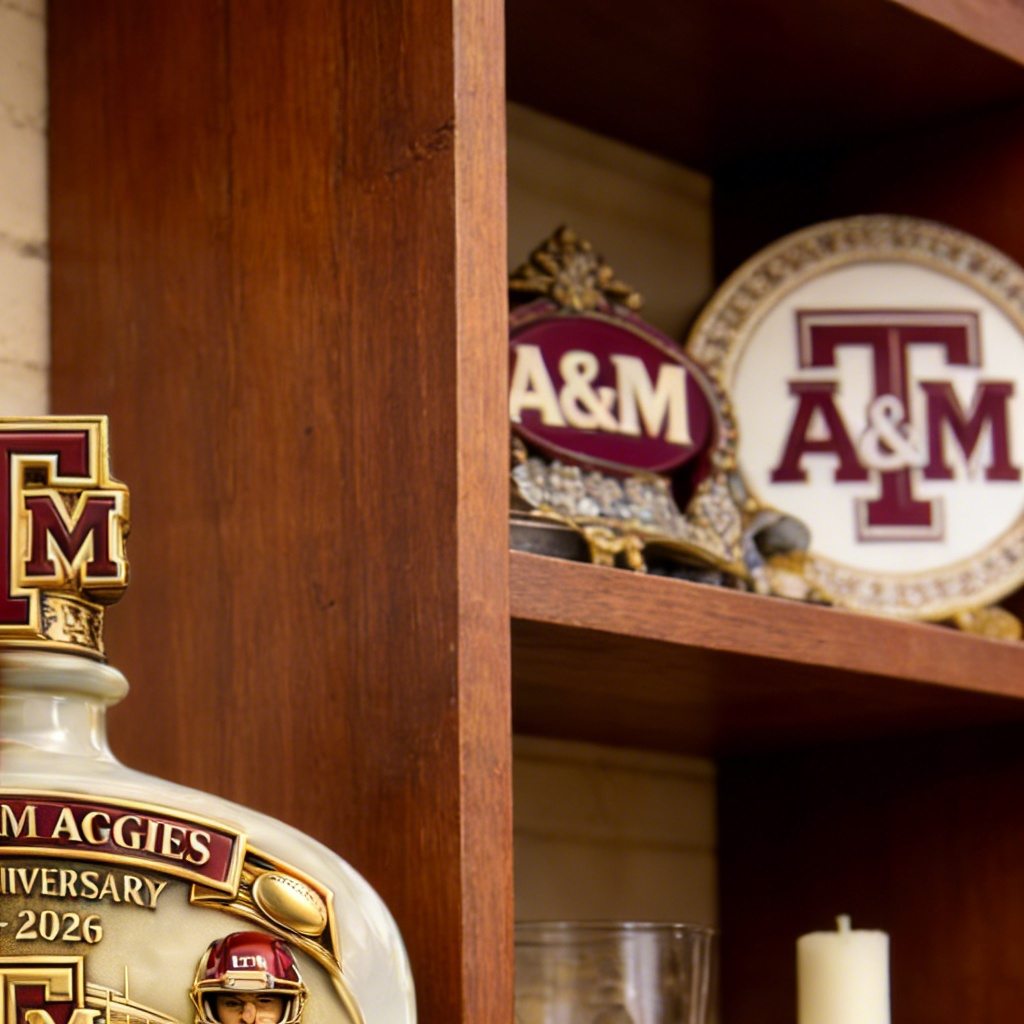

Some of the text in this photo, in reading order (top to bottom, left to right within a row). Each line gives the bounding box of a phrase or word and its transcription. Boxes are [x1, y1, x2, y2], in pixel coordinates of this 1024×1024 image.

[510, 343, 693, 447] A&M
[51, 806, 212, 867] AGGIES
[15, 910, 104, 945] 2026
